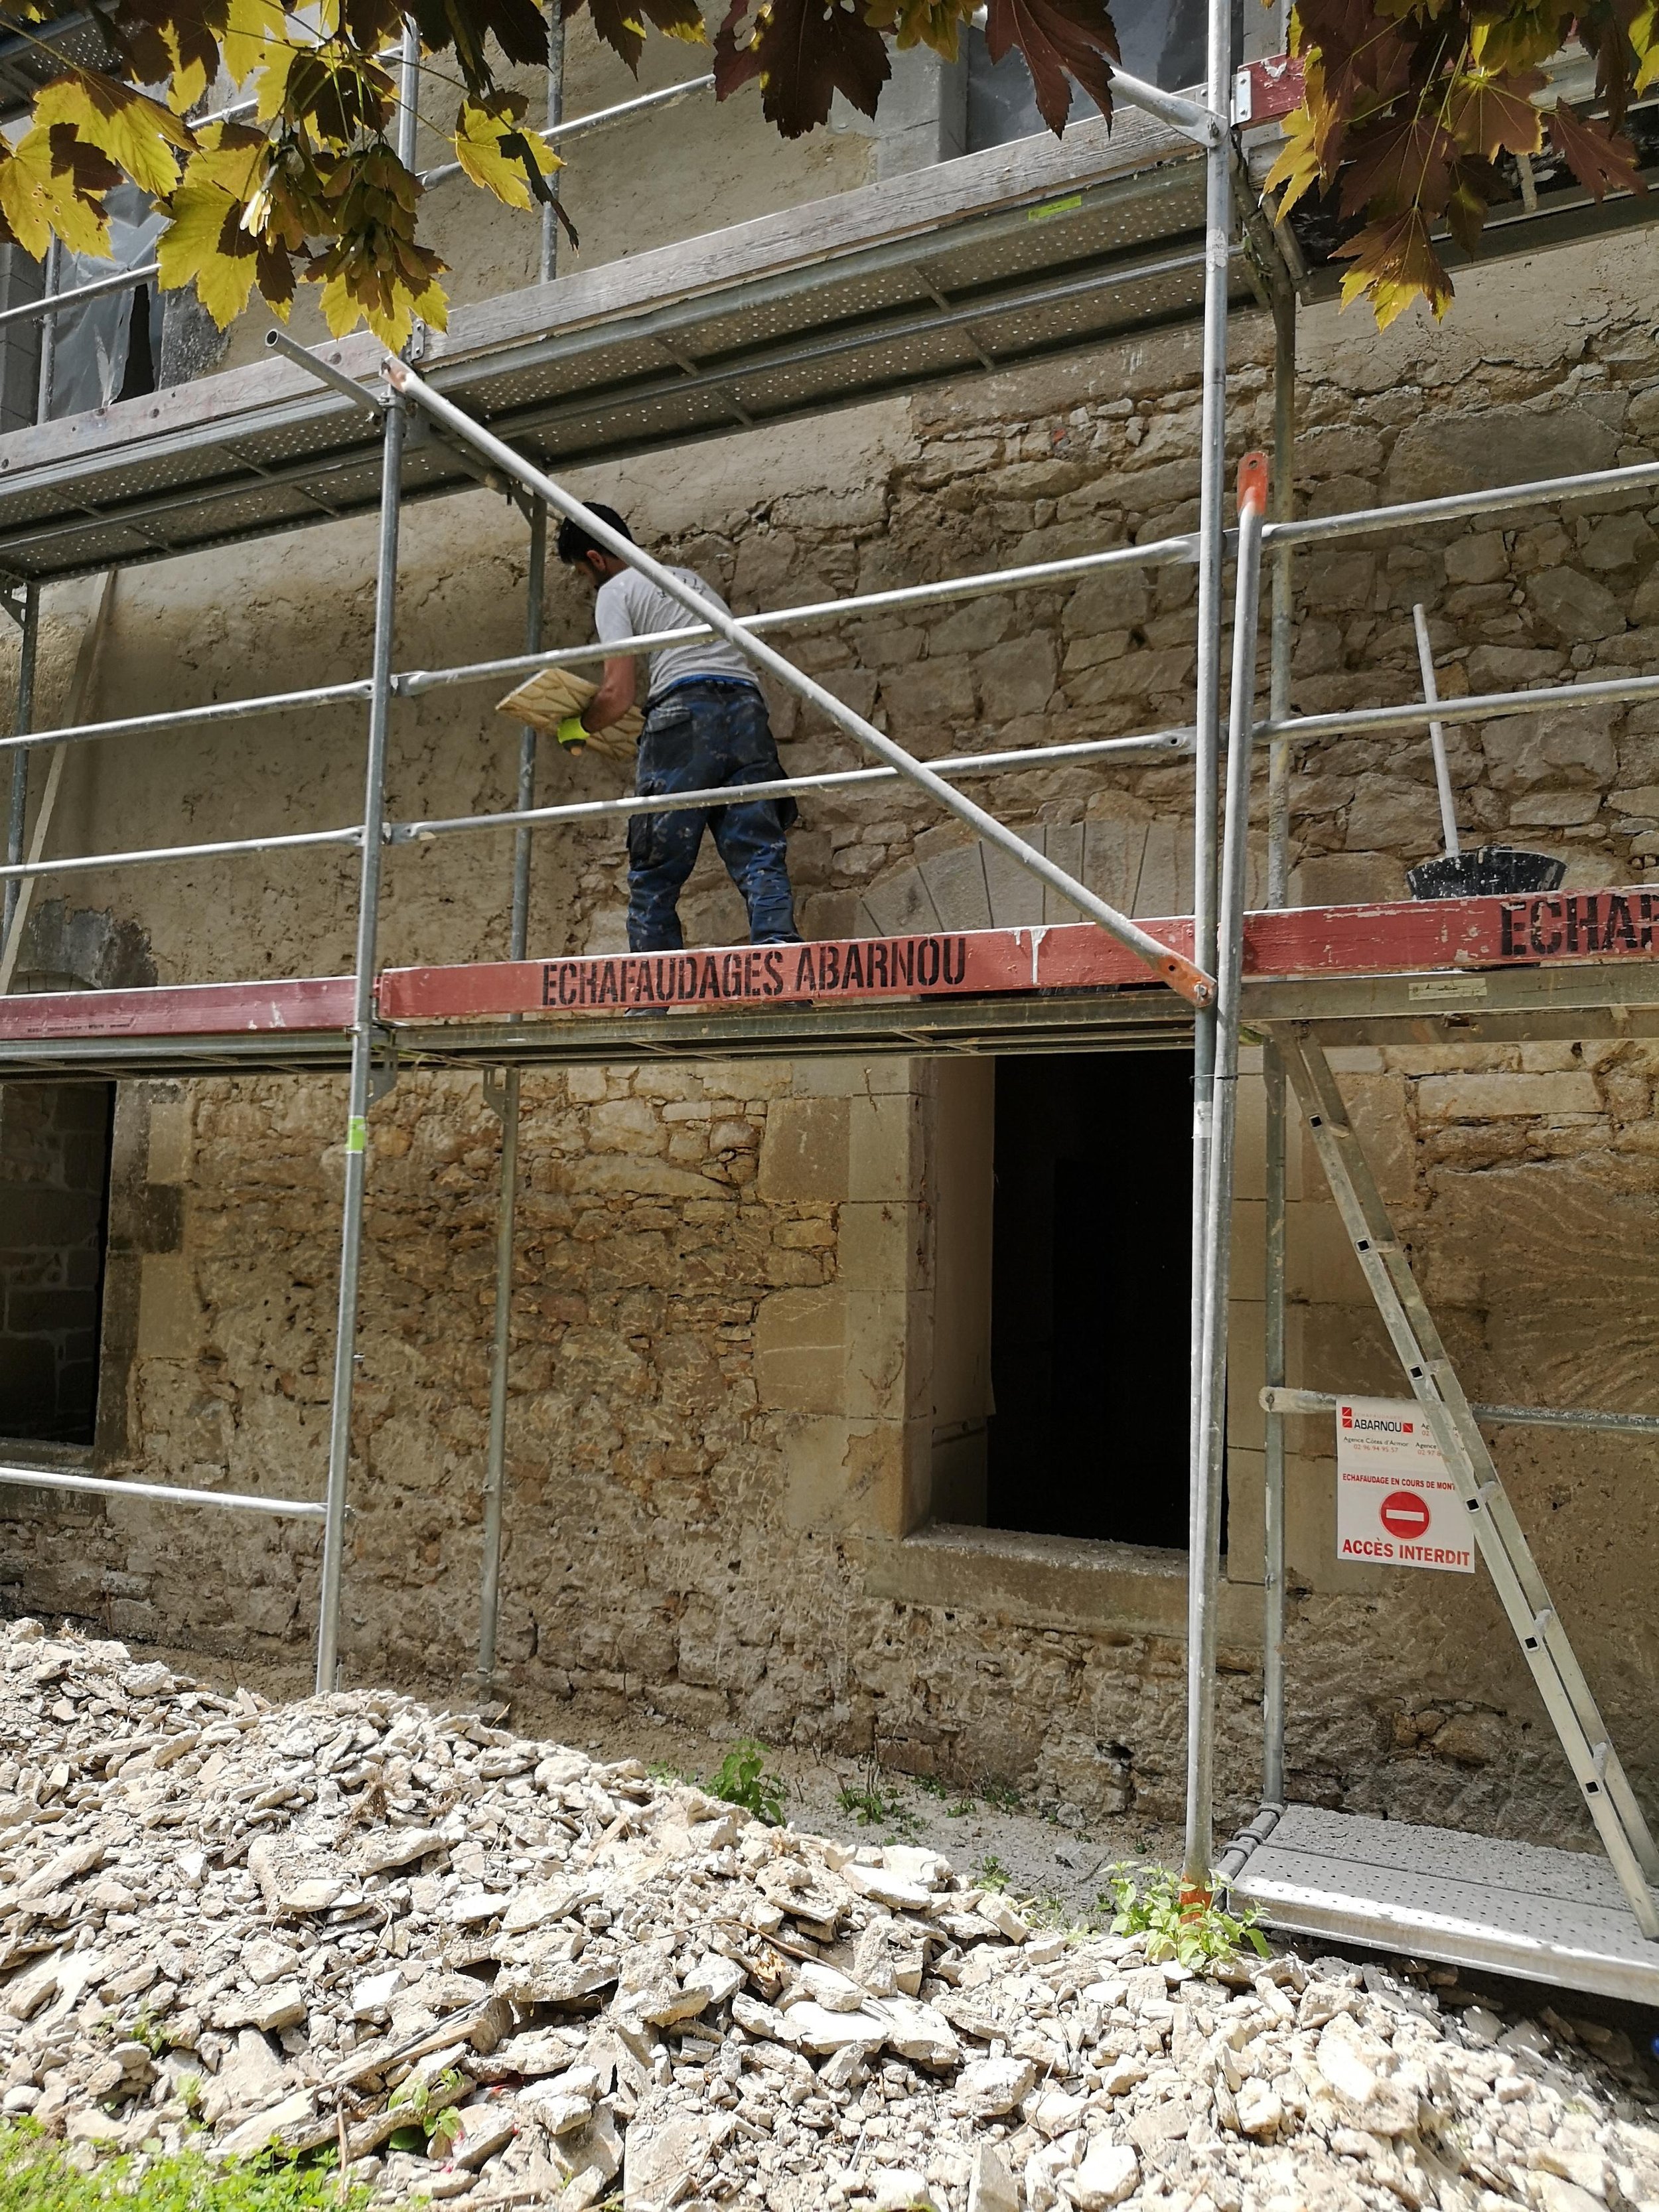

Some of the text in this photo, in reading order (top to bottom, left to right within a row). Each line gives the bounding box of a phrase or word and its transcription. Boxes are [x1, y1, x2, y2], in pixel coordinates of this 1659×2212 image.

[542, 938, 966, 1006] ECHAFAUDAGES ABARNOU
[1354, 1419, 1402, 1432] ABARNOU
[1342, 1473, 1389, 1485] ECHAFAUDAGE
[1402, 1478, 1424, 1487] COURS
[1342, 1537, 1470, 1566] ACCÈS INTERDIT
